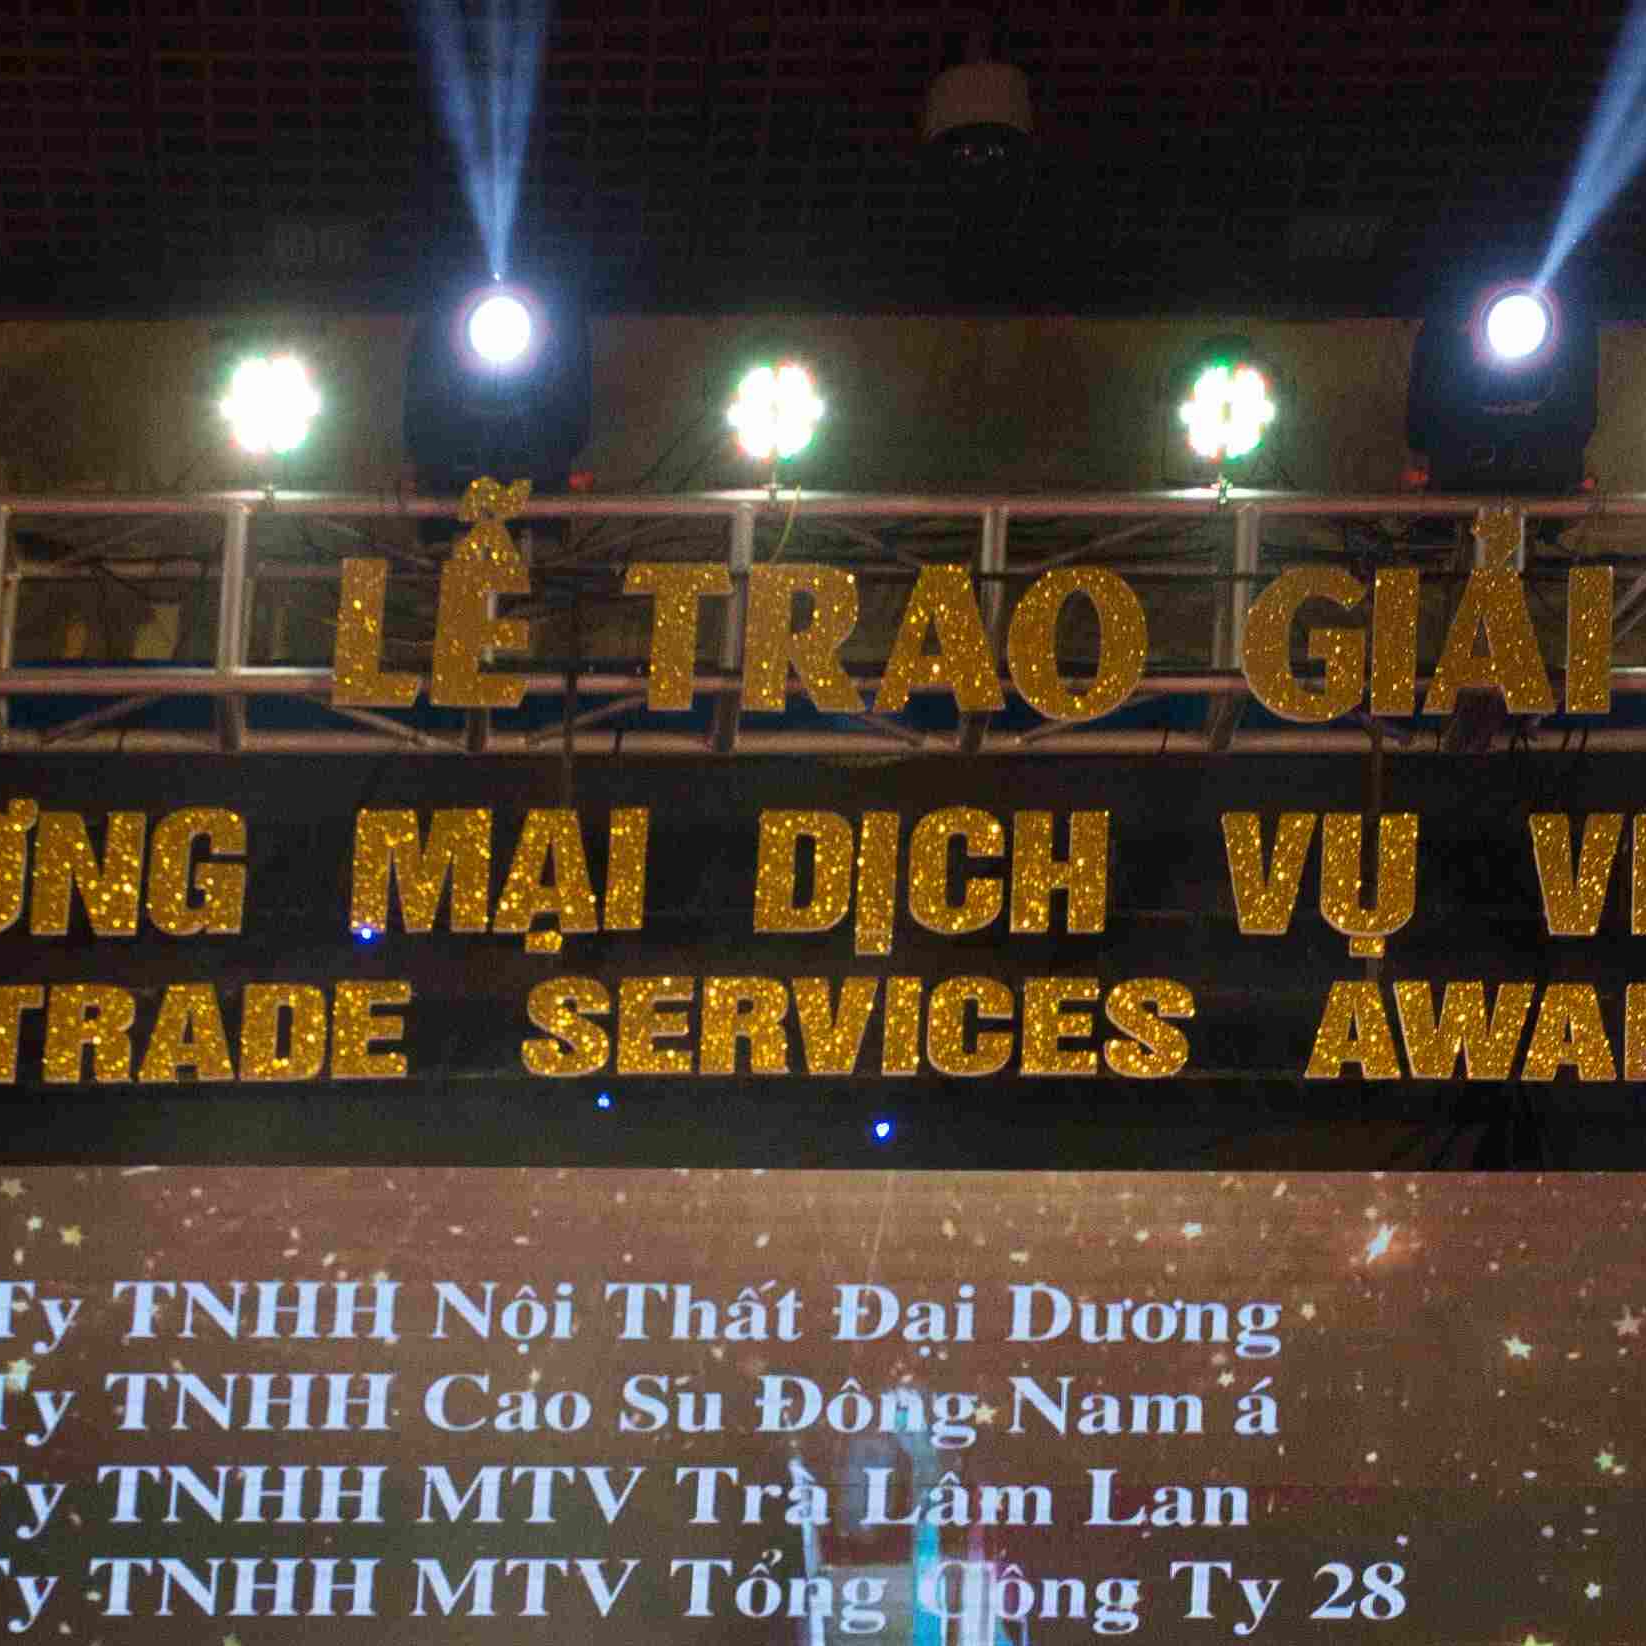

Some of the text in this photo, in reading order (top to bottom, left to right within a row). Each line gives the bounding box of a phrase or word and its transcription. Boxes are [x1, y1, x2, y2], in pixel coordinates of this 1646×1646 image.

[329, 477, 1615, 724] LỄ TRAO GIẢI
[350, 806, 650, 954] MẠI
[753, 806, 1110, 956] DỊCH
[1221, 811, 1420, 958] VỤ
[519, 973, 1197, 1080] SERVICES
[113, 1282, 400, 1339] TNHH
[433, 1282, 576, 1353] Nội
[605, 1281, 802, 1341] Thất
[833, 1284, 975, 1357] Đại
[1008, 1283, 1281, 1358] Dương
[105, 1373, 393, 1431] TNHH
[425, 1374, 591, 1432] Cao
[755, 1375, 977, 1447] Đông
[1008, 1377, 1203, 1434] Nam
[1233, 1376, 1280, 1434] á
[97, 1466, 387, 1523] TNHH
[420, 1466, 643, 1523] MTV
[675, 1461, 832, 1525] Trà
[860, 1467, 1052, 1526] Lâm
[1088, 1468, 1249, 1527] Lan
[90, 1558, 381, 1616] TNHH
[412, 1558, 640, 1617] MTV
[670, 1549, 887, 1635] Tổng
[917, 1559, 1141, 1634] Công
[1170, 1561, 1282, 1635] Ty
[1310, 1561, 1407, 1619] 28
